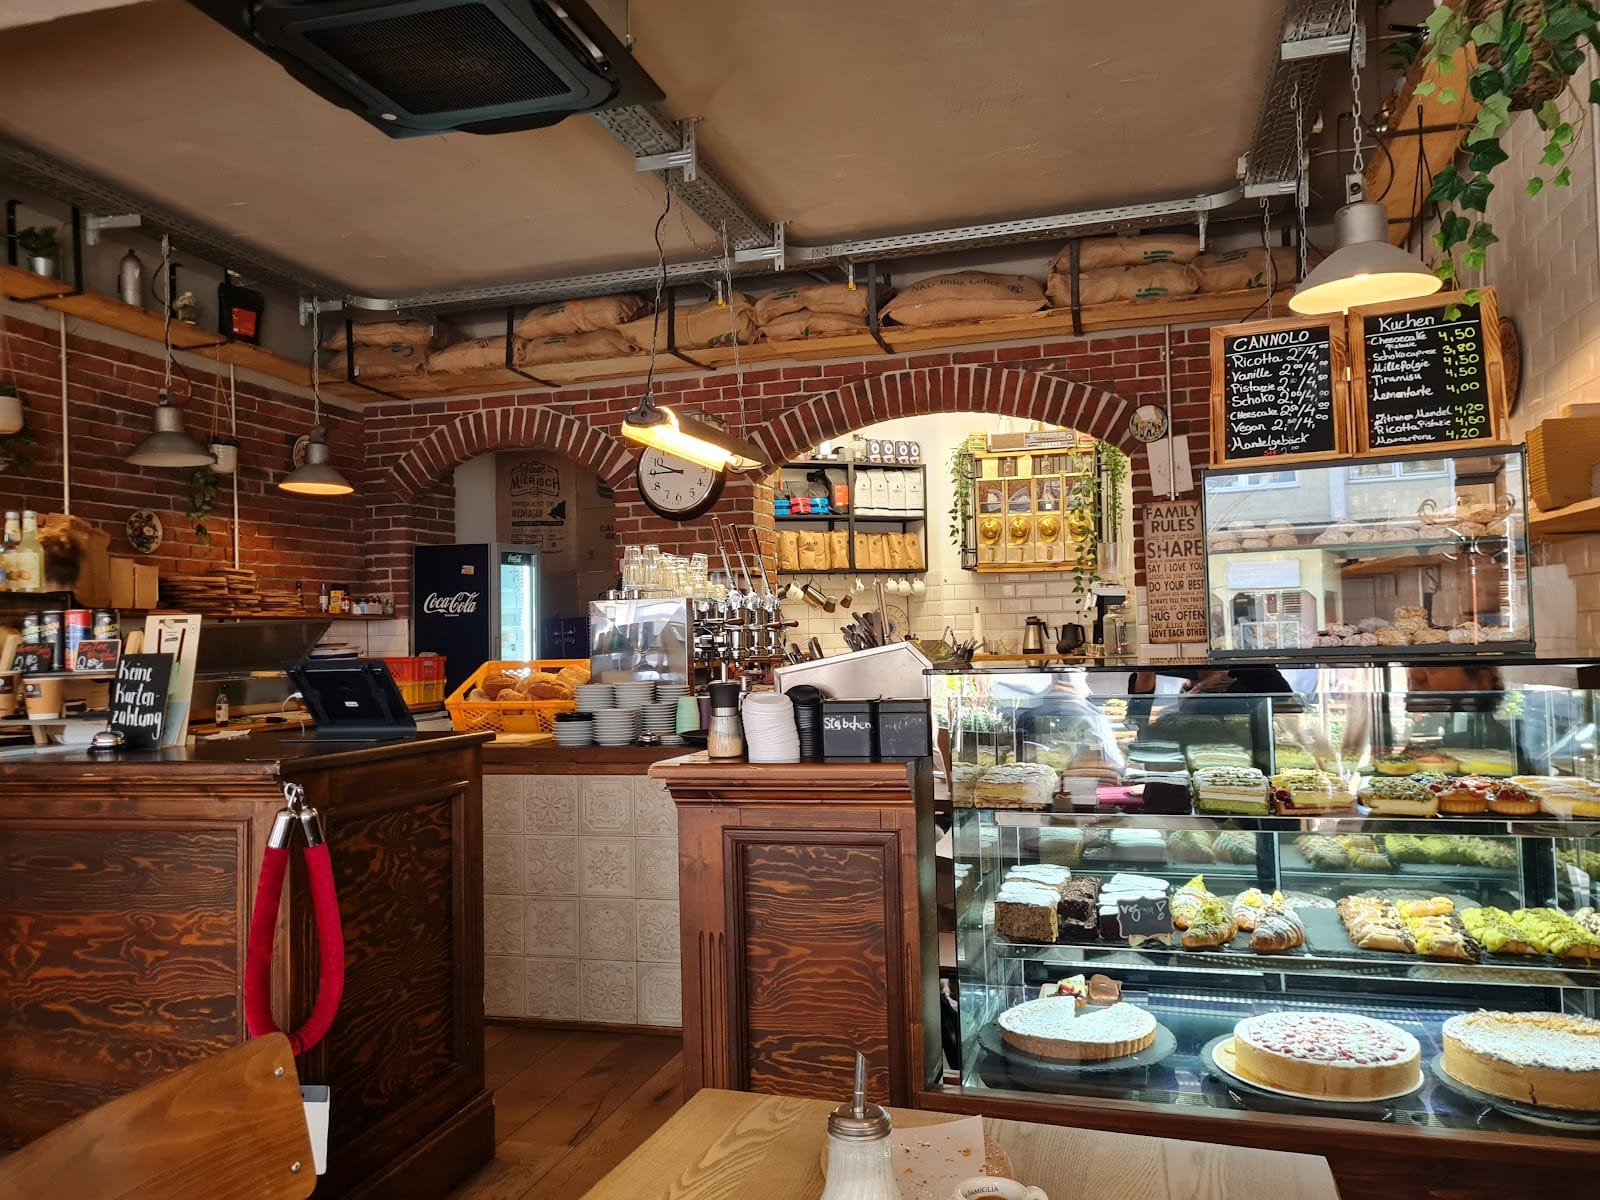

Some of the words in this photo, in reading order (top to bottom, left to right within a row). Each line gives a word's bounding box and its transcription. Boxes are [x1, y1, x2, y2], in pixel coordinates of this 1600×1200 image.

[1378, 313, 1435, 333] Kuchen
[1233, 330, 1310, 352] CANNOLO
[1438, 327, 1476, 342] 4,50
[1442, 342, 1476, 355] 3,80
[1231, 352, 1283, 368] Ricotta
[1443, 353, 1480, 366] 4,50
[1232, 367, 1273, 382] Vanille
[1371, 372, 1422, 387] Tiramisu
[1445, 366, 1477, 378] 4,50
[1446, 381, 1480, 394] 4,00
[1232, 393, 1275, 407] Schoko
[1454, 403, 1485, 416] 4,20
[1231, 422, 1267, 435] Vegan
[1374, 422, 1420, 435] Ricotta
[1446, 427, 1480, 439] 4,20
[1231, 432, 1310, 451] Mandelgebäck
[654, 457, 664, 467] 10
[650, 469, 657, 478] 9
[511, 474, 560, 490] MIERISCH
[654, 482, 661, 491] 8
[697, 478, 703, 487] 4
[664, 490, 670, 499] 7
[675, 492, 682, 502] 6
[1146, 504, 1199, 520] FAMILY
[1151, 518, 1196, 533] RULES
[1147, 539, 1203, 559] SHARE
[1147, 564, 1160, 573] SAY
[1170, 562, 1186, 572] LOVE
[1190, 561, 1204, 571] YOU
[1149, 581, 1161, 592] DO
[1164, 580, 1184, 591] YOUR
[1188, 579, 1204, 590] BEST
[423, 592, 480, 614] Coca-Cola
[1151, 611, 1170, 621] HUG
[1176, 610, 1205, 620] OFTEN
[1151, 629, 1167, 638] LOVE
[1169, 628, 1184, 637] EACH
[1186, 628, 1206, 637] OTHER
[119, 660, 153, 682] Keine
[115, 683, 160, 706] Karten-
[111, 705, 162, 740] zahlung
[823, 715, 872, 731] Stäbchen
